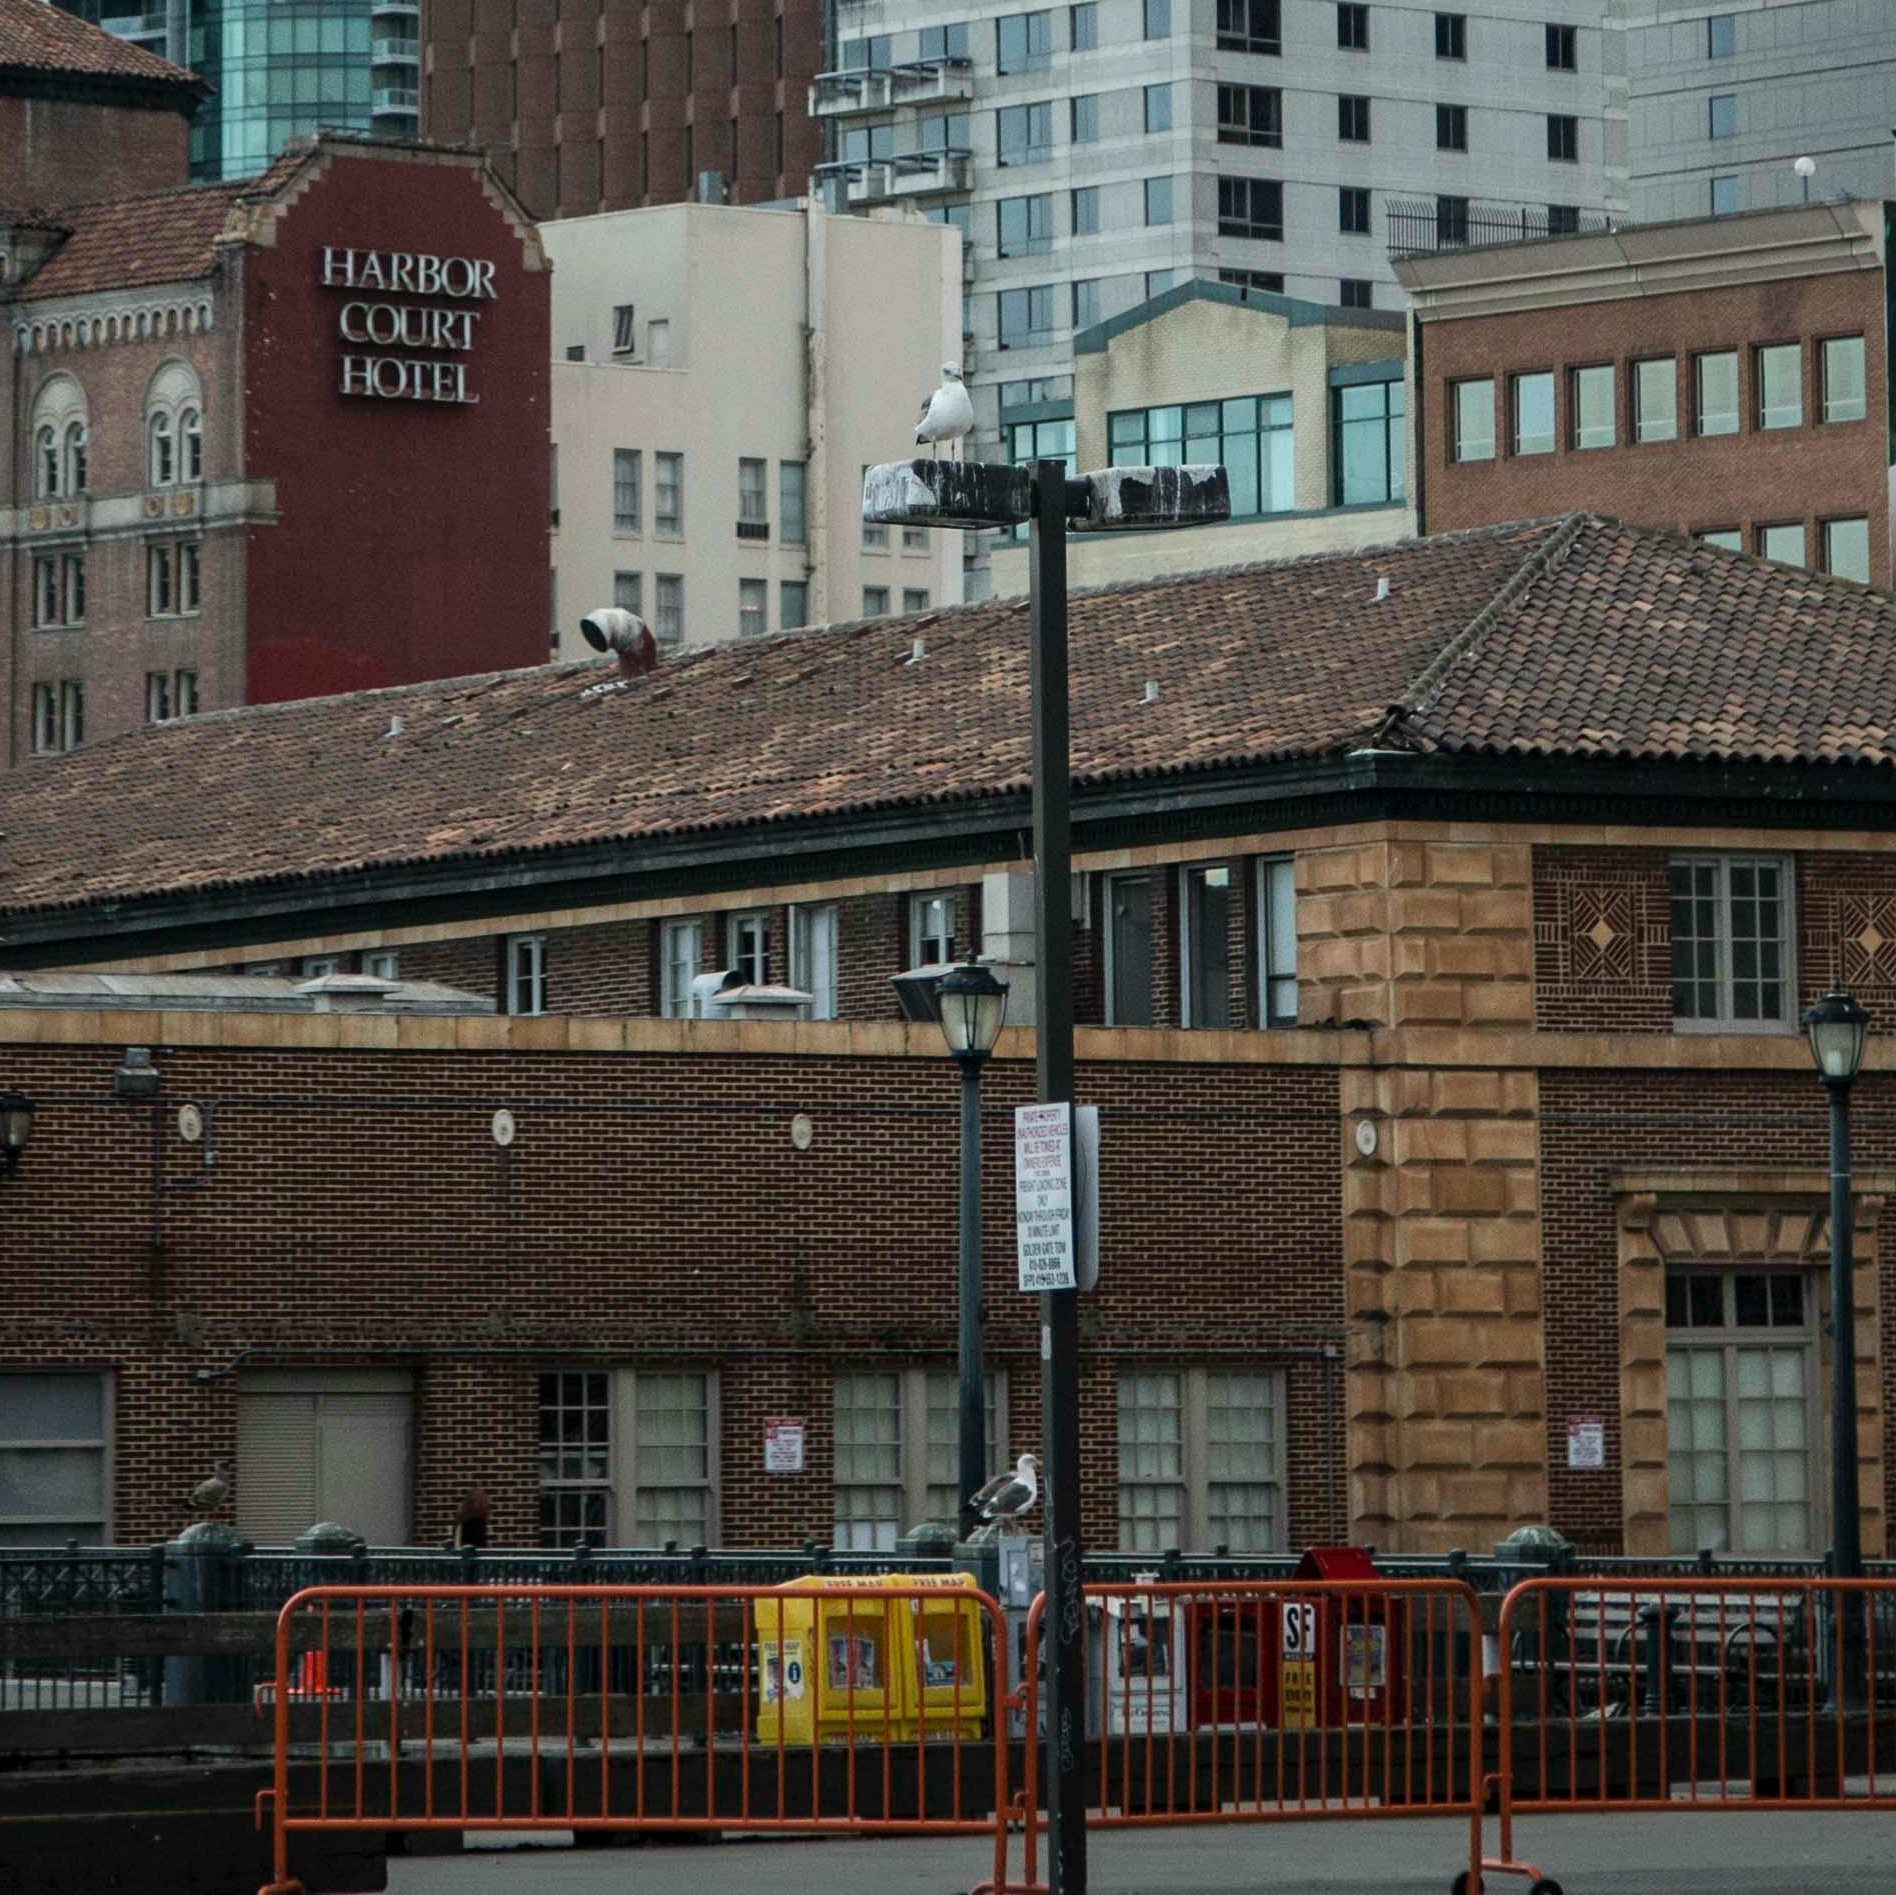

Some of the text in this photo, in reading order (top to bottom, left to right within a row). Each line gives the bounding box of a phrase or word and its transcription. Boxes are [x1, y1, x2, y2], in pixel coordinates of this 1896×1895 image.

[321, 246, 498, 299] HARBOR
[339, 302, 481, 350] COURT
[340, 355, 480, 404] HOTEL
[1285, 1671, 1312, 1685] FRE
